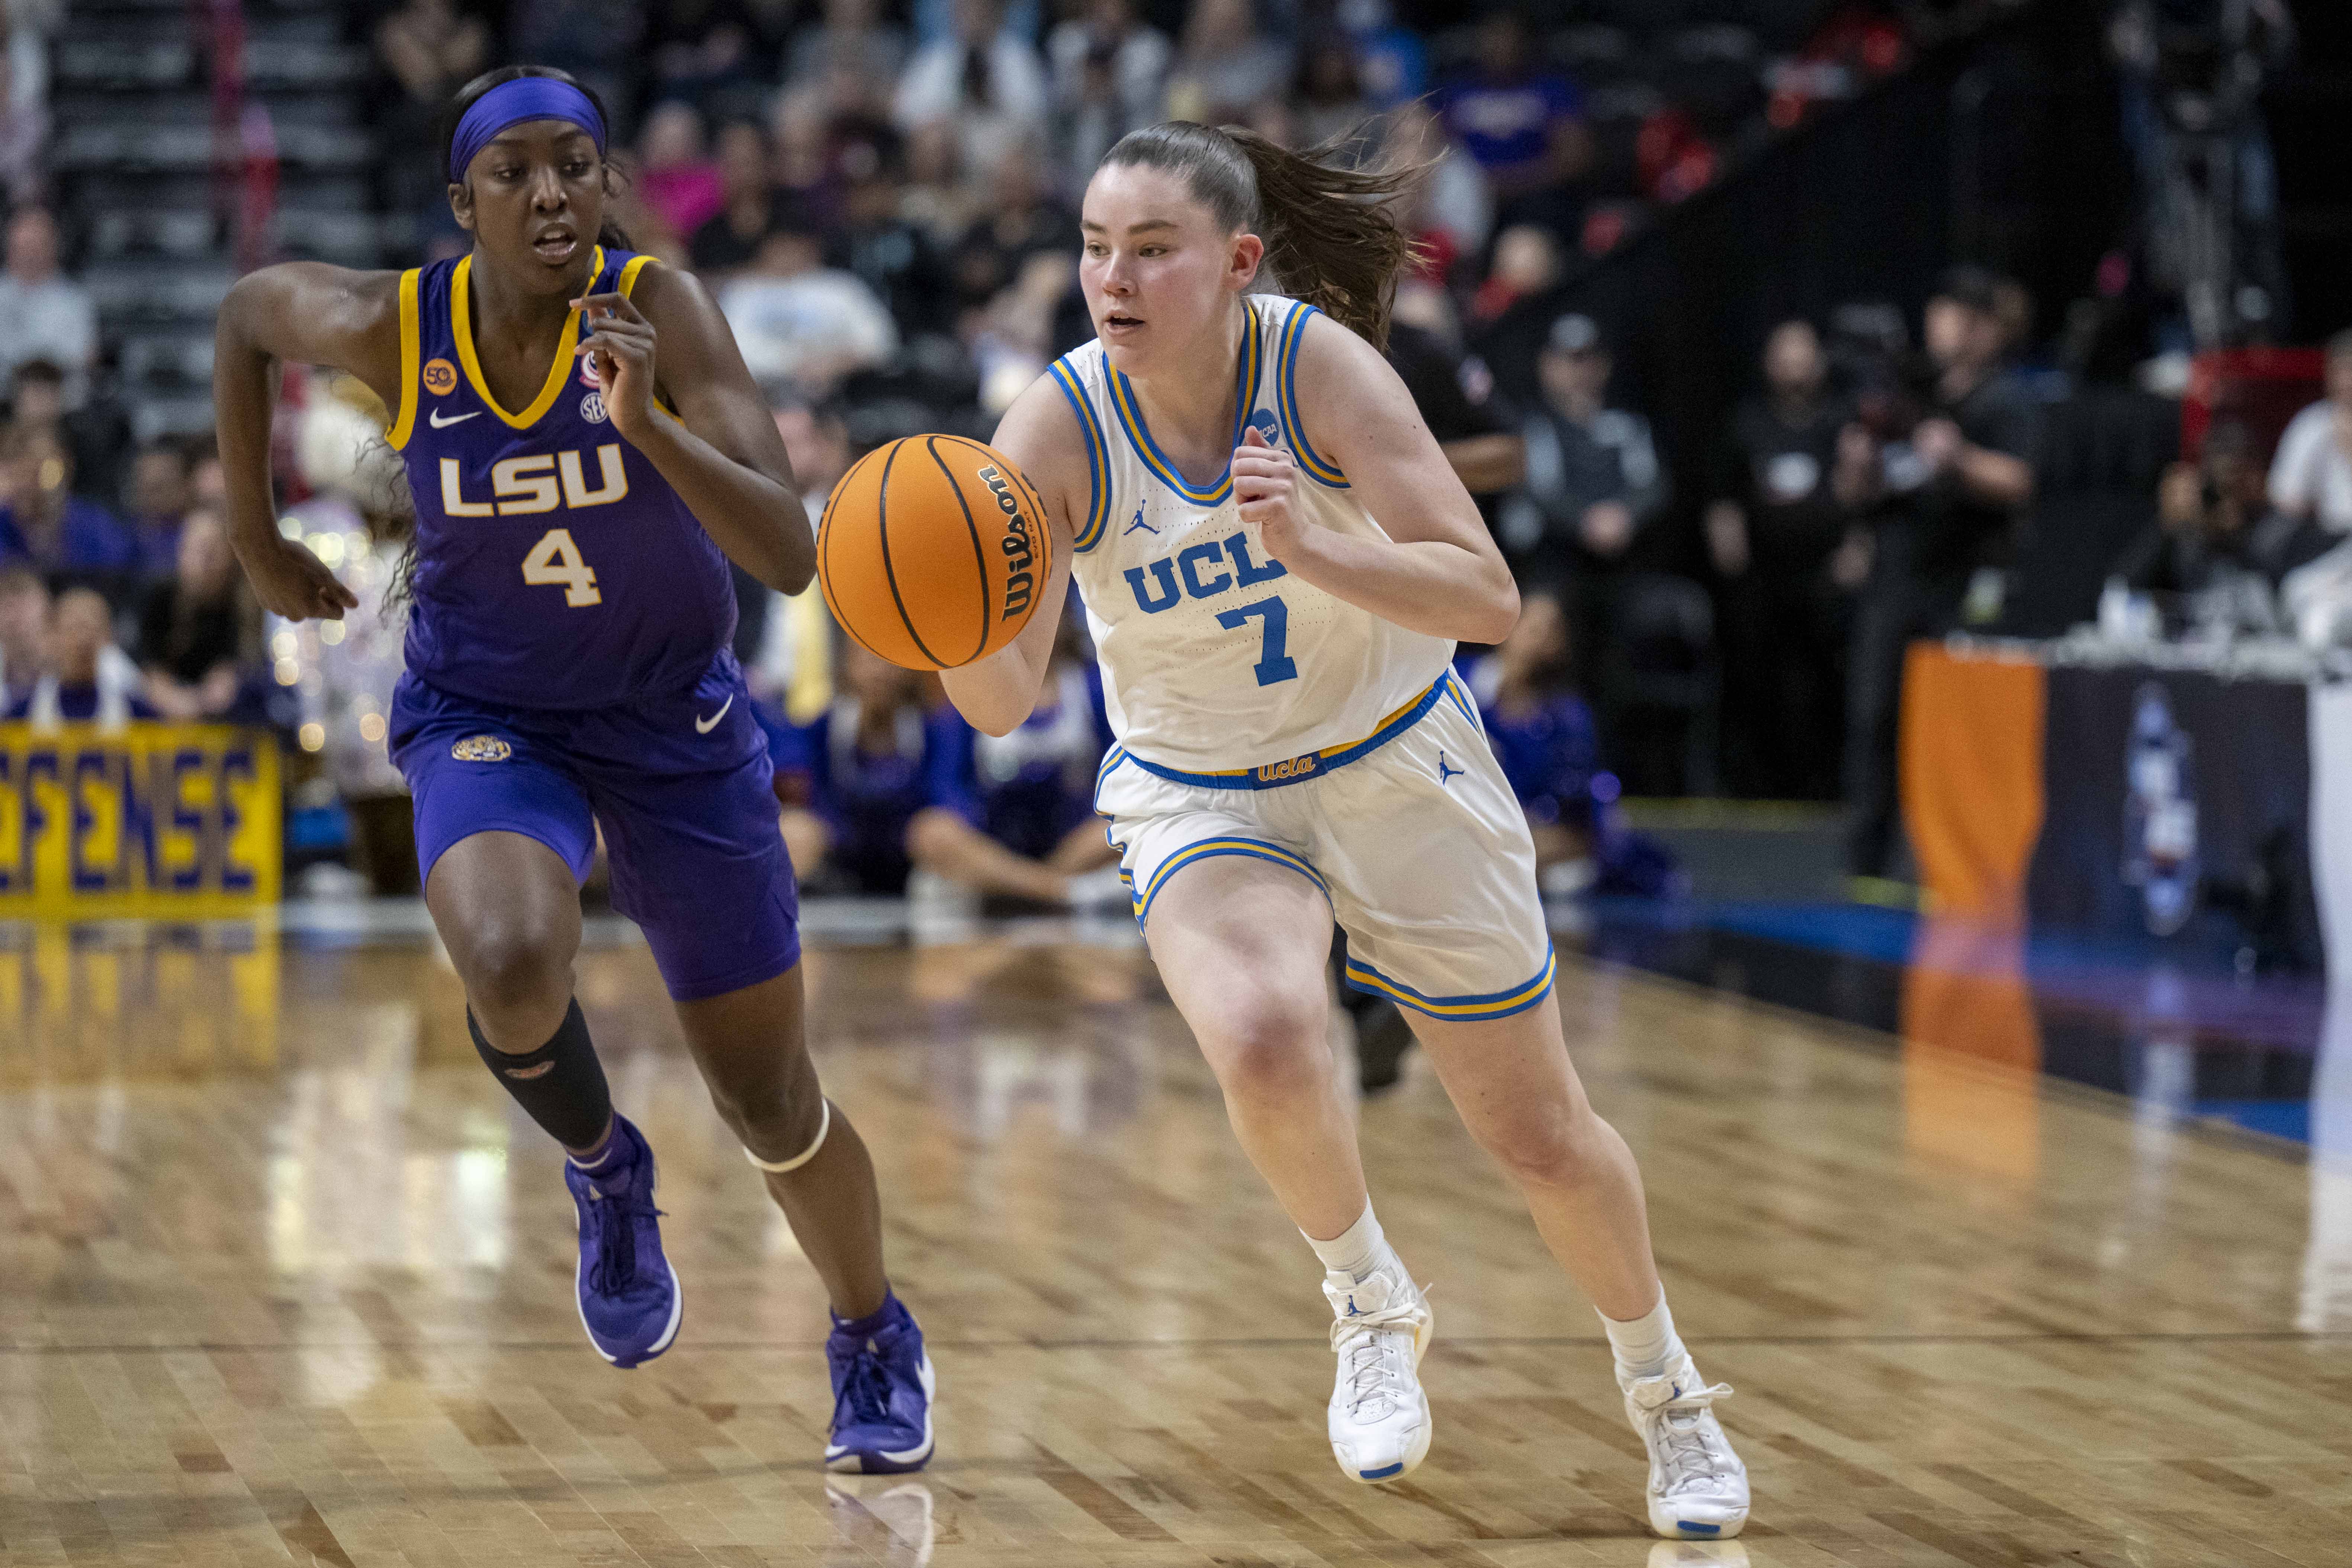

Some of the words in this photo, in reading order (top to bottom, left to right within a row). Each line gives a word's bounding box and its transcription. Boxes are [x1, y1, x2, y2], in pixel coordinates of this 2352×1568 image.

[1258, 423, 1277, 438] CAA
[440, 443, 629, 517] LSU
[521, 528, 602, 608] 4
[978, 464, 1034, 622] Wilson
[1123, 531, 1288, 614] UCL
[1214, 595, 1298, 687] 7
